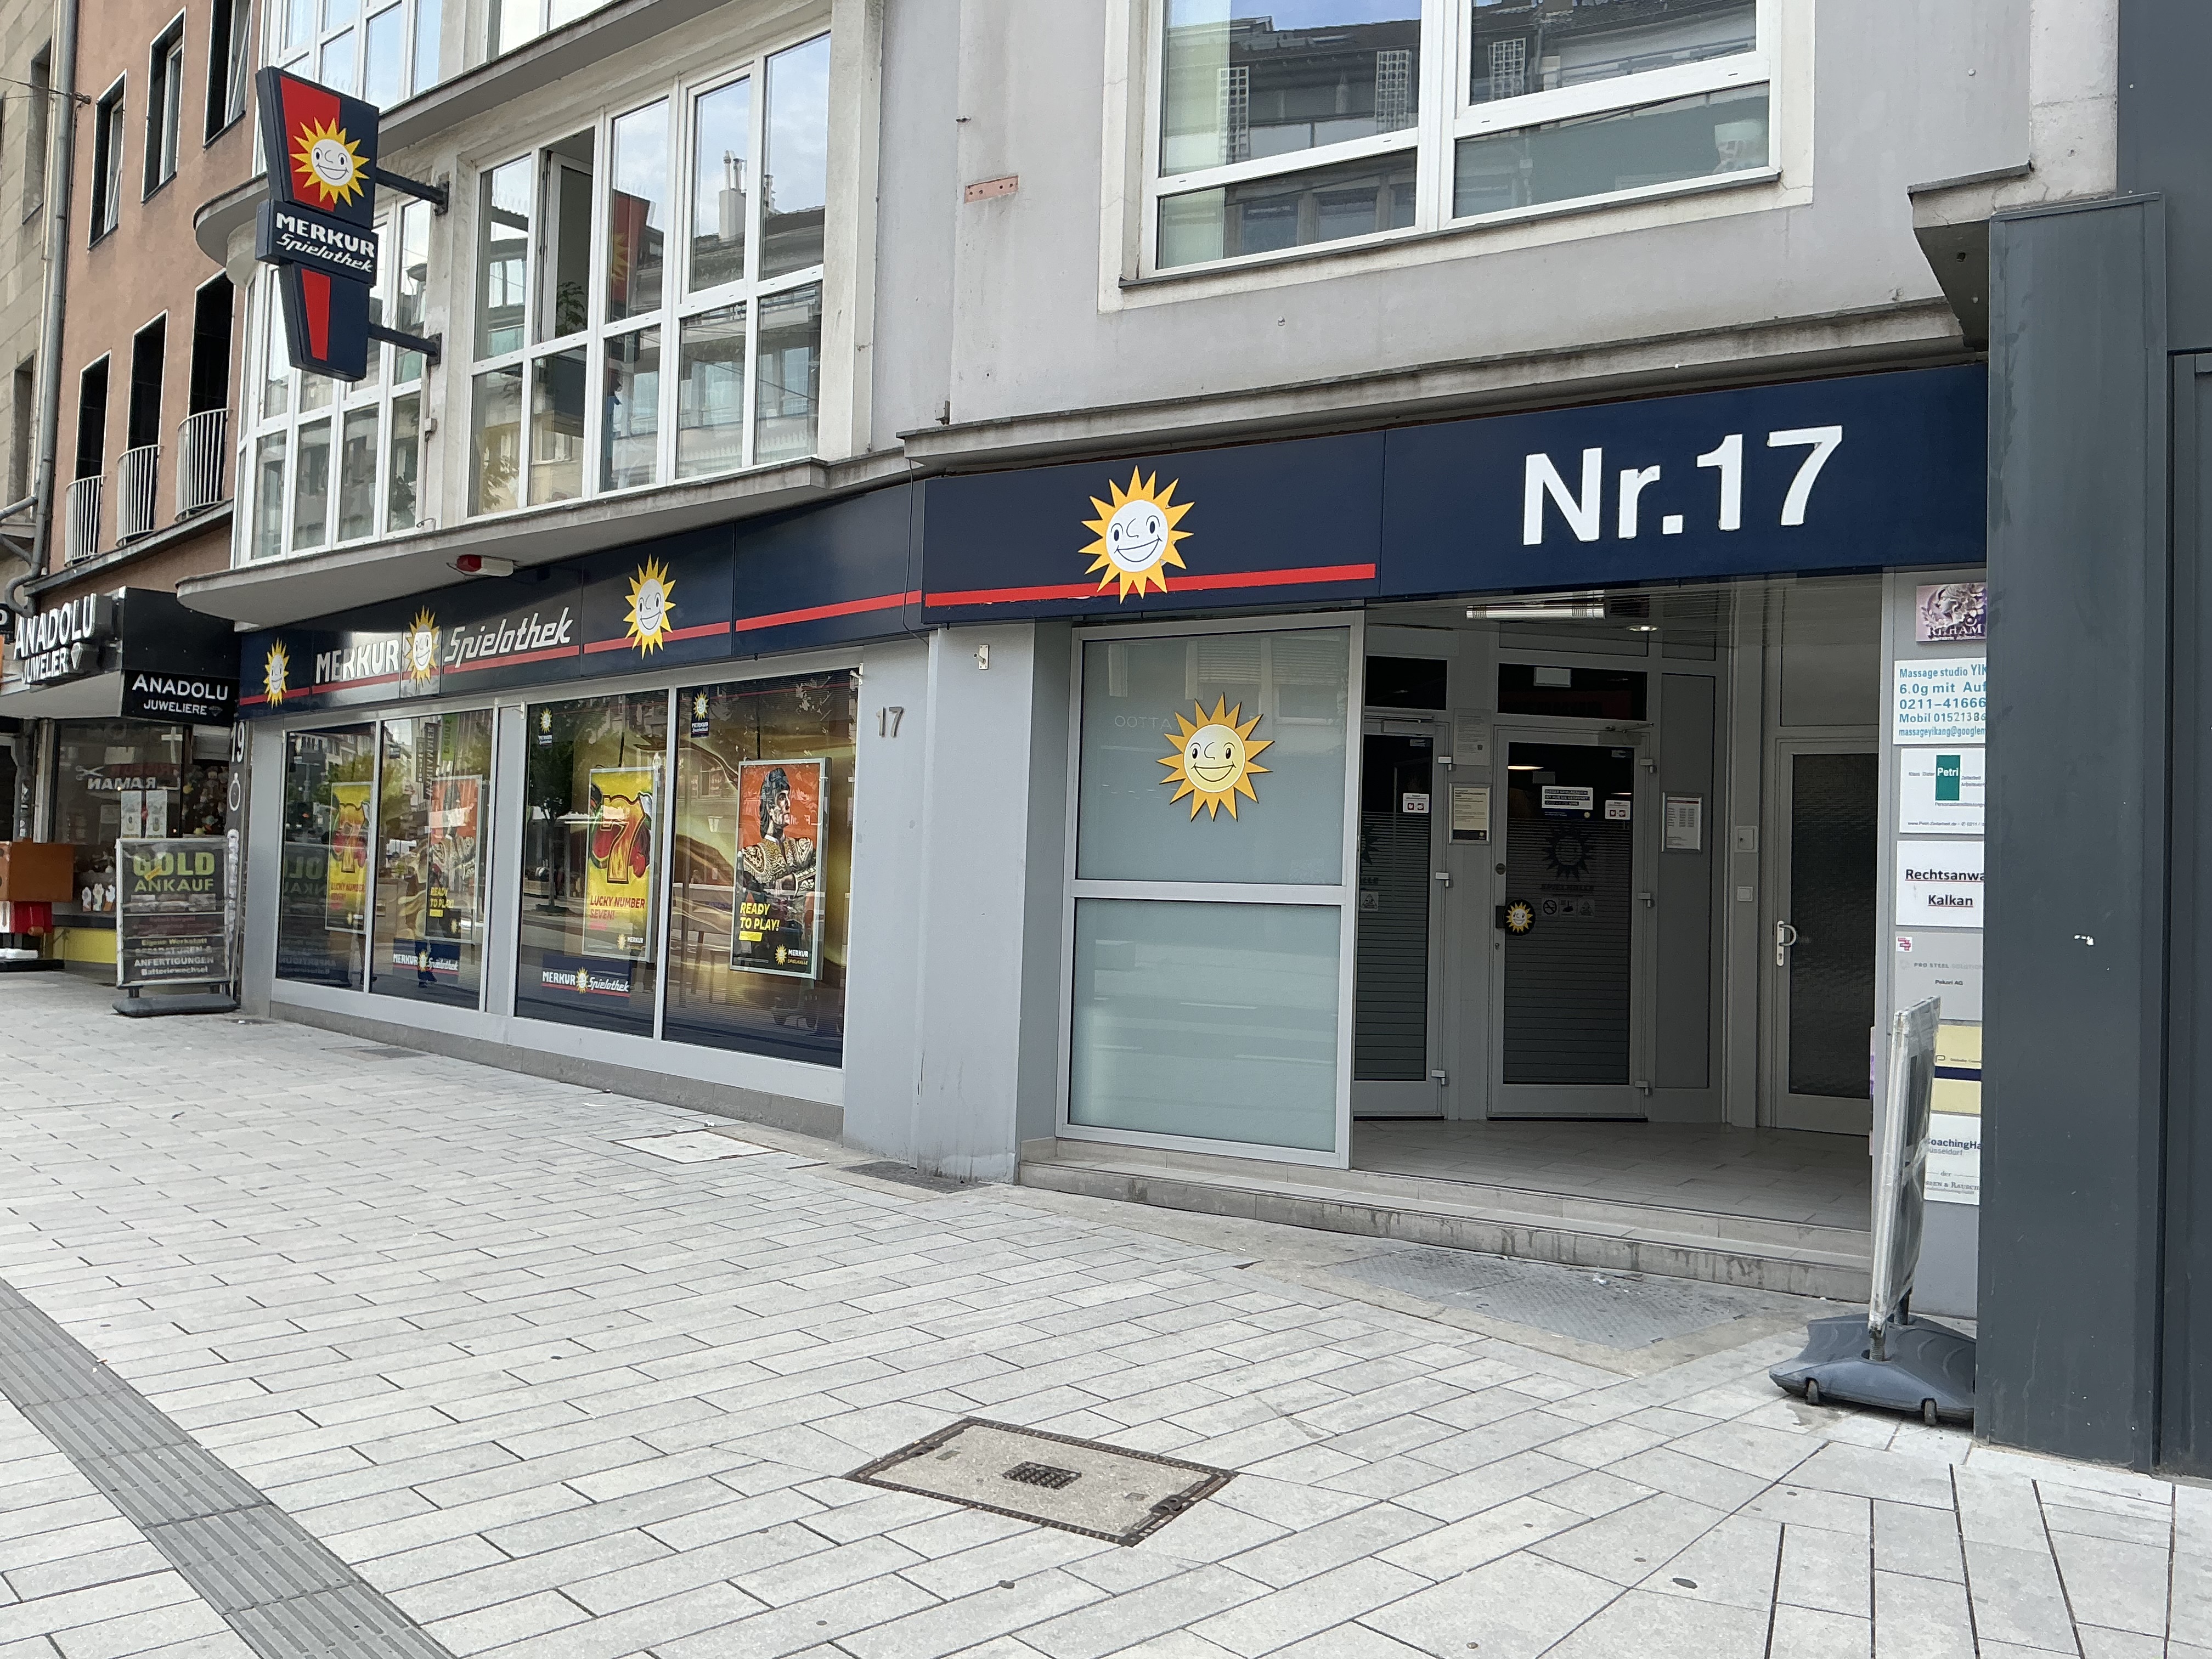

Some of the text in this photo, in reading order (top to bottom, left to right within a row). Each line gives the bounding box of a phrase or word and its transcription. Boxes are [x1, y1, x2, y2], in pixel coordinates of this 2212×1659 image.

[276, 212, 375, 258] MERKUR
[276, 233, 374, 273] Spielothek
[14, 592, 96, 660] ANADOLU
[316, 607, 573, 684] MERKUR Spielothek
[22, 647, 69, 684] JUWELIER
[1899, 668, 1938, 679] Massage
[1940, 667, 1968, 676] studio
[132, 674, 228, 701] ANADOLU
[1933, 682, 1955, 693] mit
[143, 699, 207, 716] JUWELIERE
[876, 706, 905, 738] 17
[1899, 713, 1931, 723] Mobil
[231, 721, 245, 763] 19
[1937, 767, 1959, 777] Petri
[133, 851, 215, 876] GOLD
[134, 878, 214, 893] ANKAUF
[590, 895, 645, 909] LUCKY NUMBER
[1928, 894, 1973, 906] Kalkan
[589, 909, 615, 921] SEVEN!
[740, 902, 770, 916] READY
[740, 917, 780, 932] TO PLAY!
[788, 949, 809, 958] MERKUR
[542, 971, 630, 992] MERKUR Spielothek
